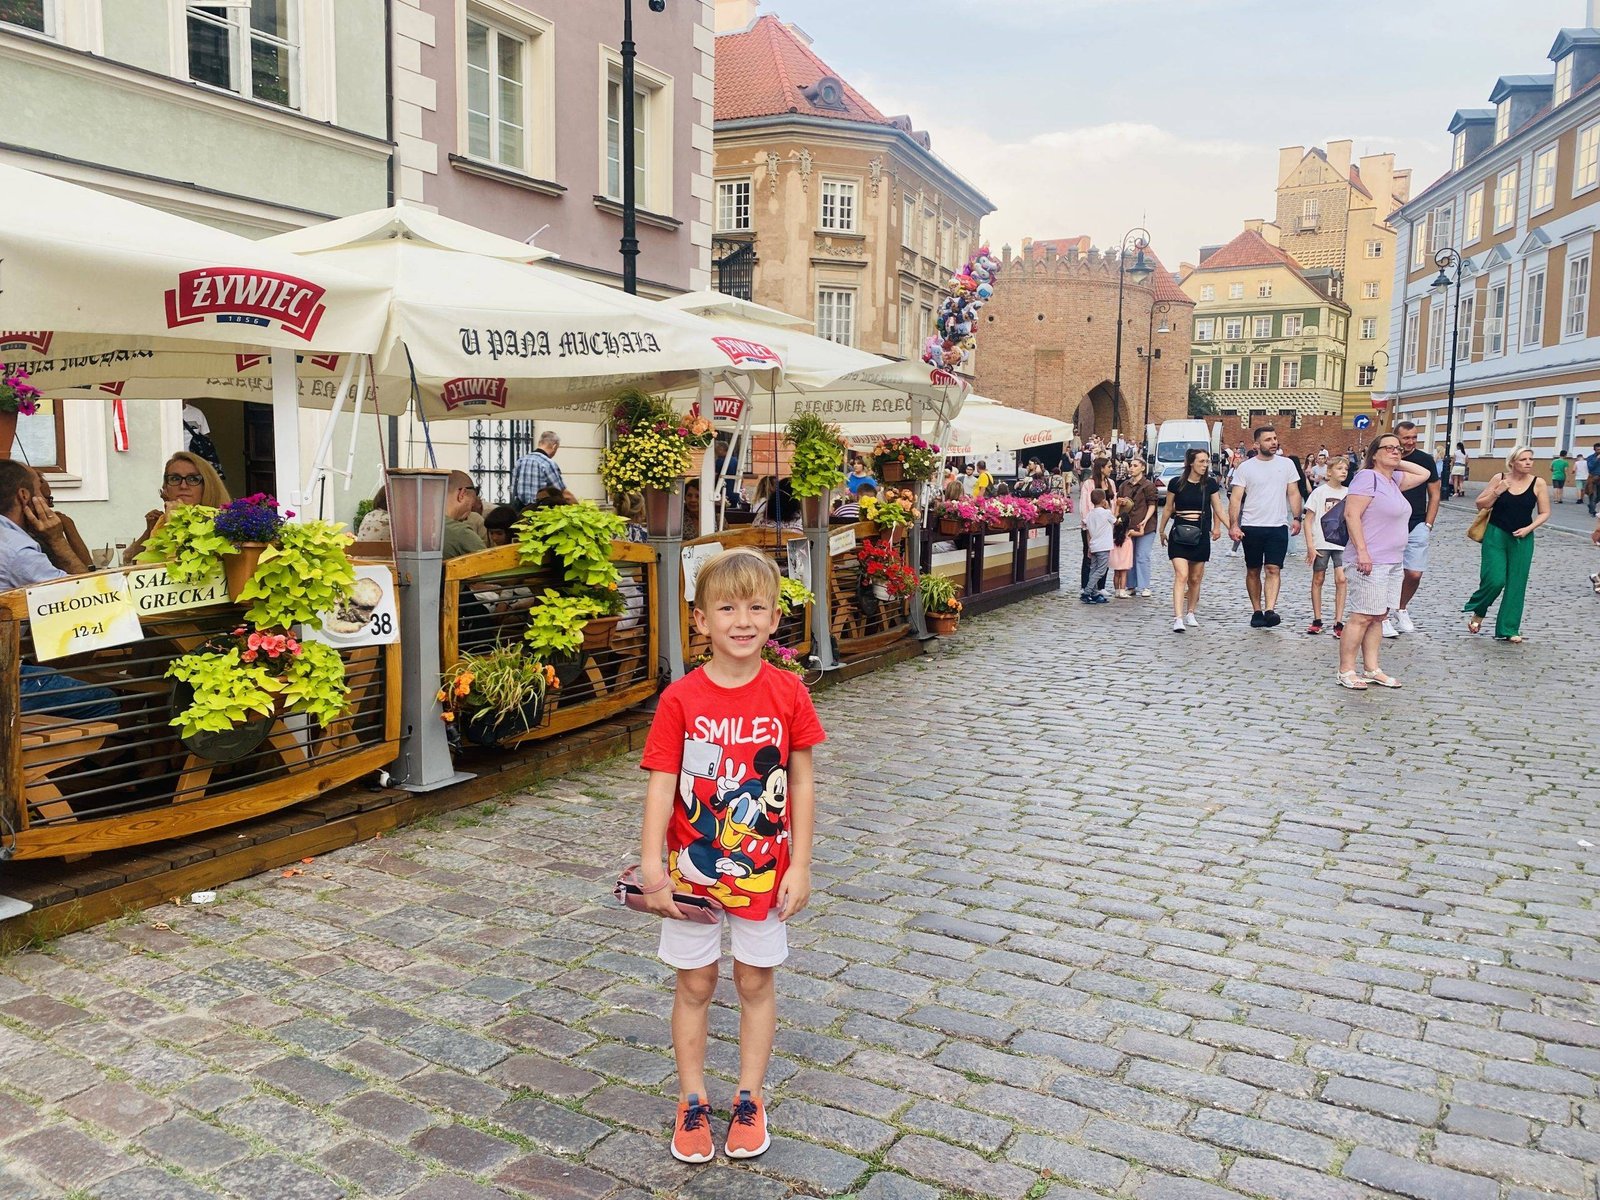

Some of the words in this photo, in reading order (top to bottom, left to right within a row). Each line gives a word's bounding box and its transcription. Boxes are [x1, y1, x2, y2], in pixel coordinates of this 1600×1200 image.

[191, 271, 314, 318] ŻYWIEC
[228, 316, 259, 325] 1856
[459, 328, 482, 356] U
[486, 329, 551, 360] PANA
[36, 590, 122, 618] CHŁODNIK
[140, 587, 215, 610] GRECKA
[71, 625, 90, 640] 12
[91, 622, 104, 636] zł
[370, 612, 392, 636] 38
